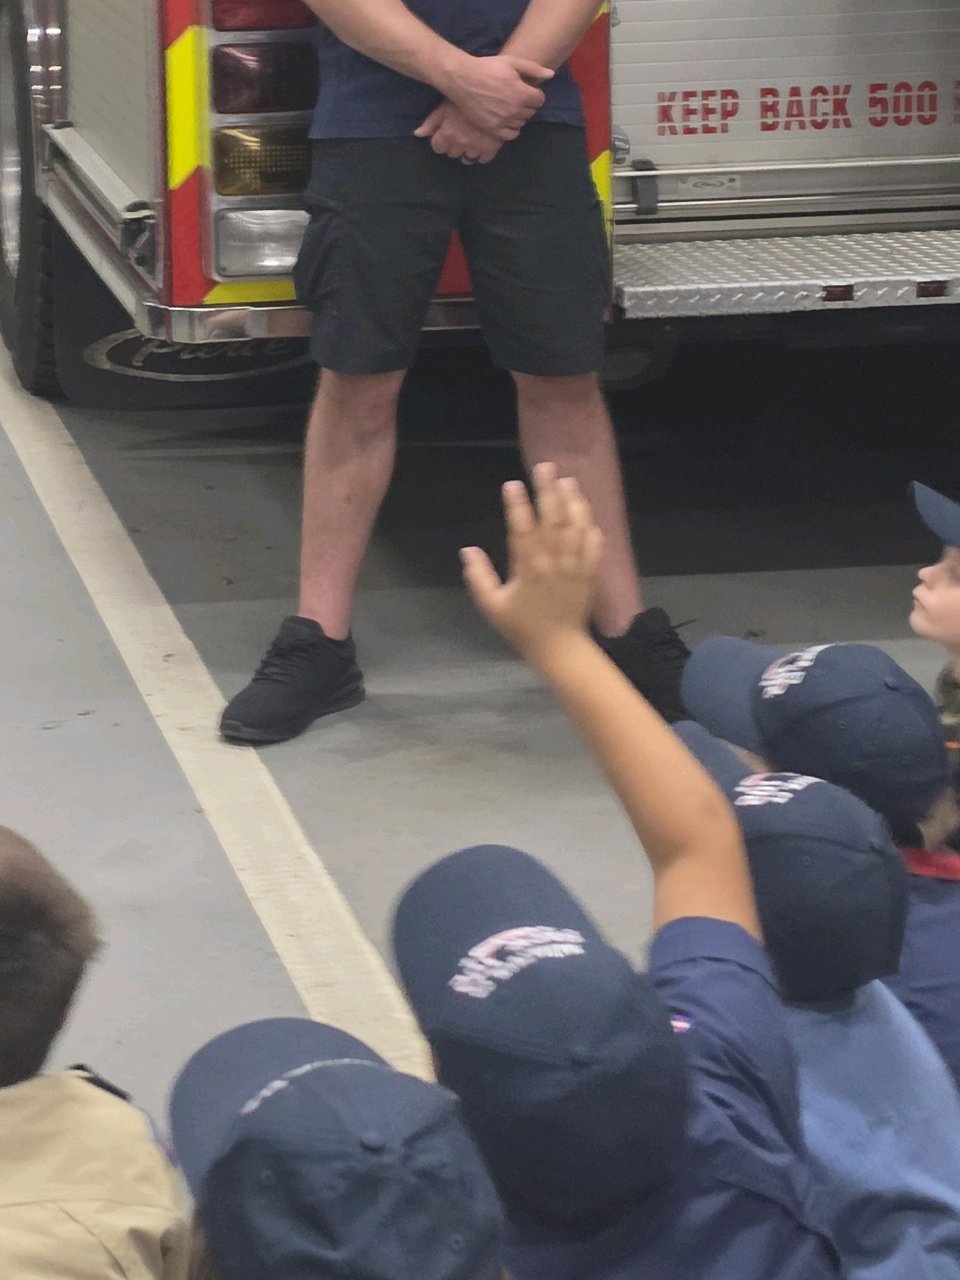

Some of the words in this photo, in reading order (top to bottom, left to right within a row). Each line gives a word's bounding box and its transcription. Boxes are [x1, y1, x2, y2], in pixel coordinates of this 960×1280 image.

[656, 88, 740, 137] KEEP
[758, 84, 853, 132] BACK
[867, 80, 939, 128] 500
